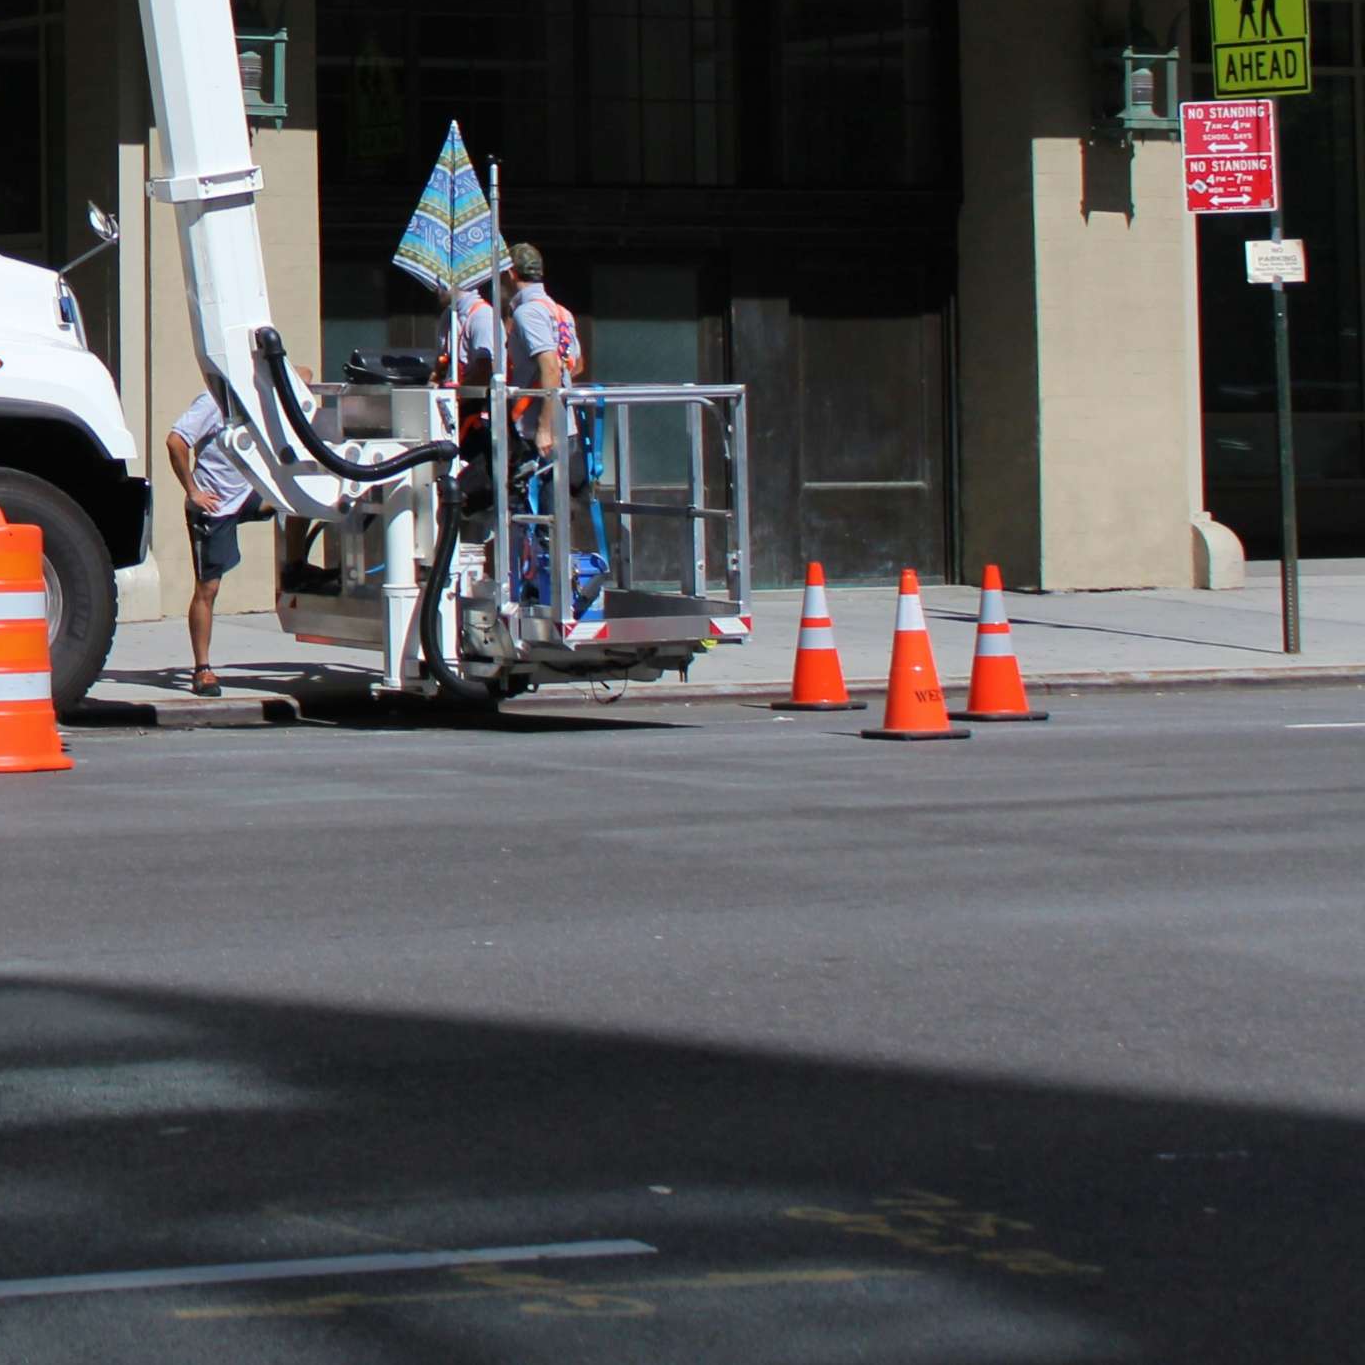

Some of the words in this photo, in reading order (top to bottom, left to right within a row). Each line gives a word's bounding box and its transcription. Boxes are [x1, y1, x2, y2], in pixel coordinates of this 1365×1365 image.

[1226, 48, 1297, 83] AHEAD
[1187, 108, 1204, 120] NO
[1209, 106, 1265, 118] STANDING
[1202, 133, 1231, 141] SCHOOL
[1233, 132, 1253, 140] DAYS
[1190, 161, 1206, 172] NO
[1211, 159, 1267, 172] STANDING
